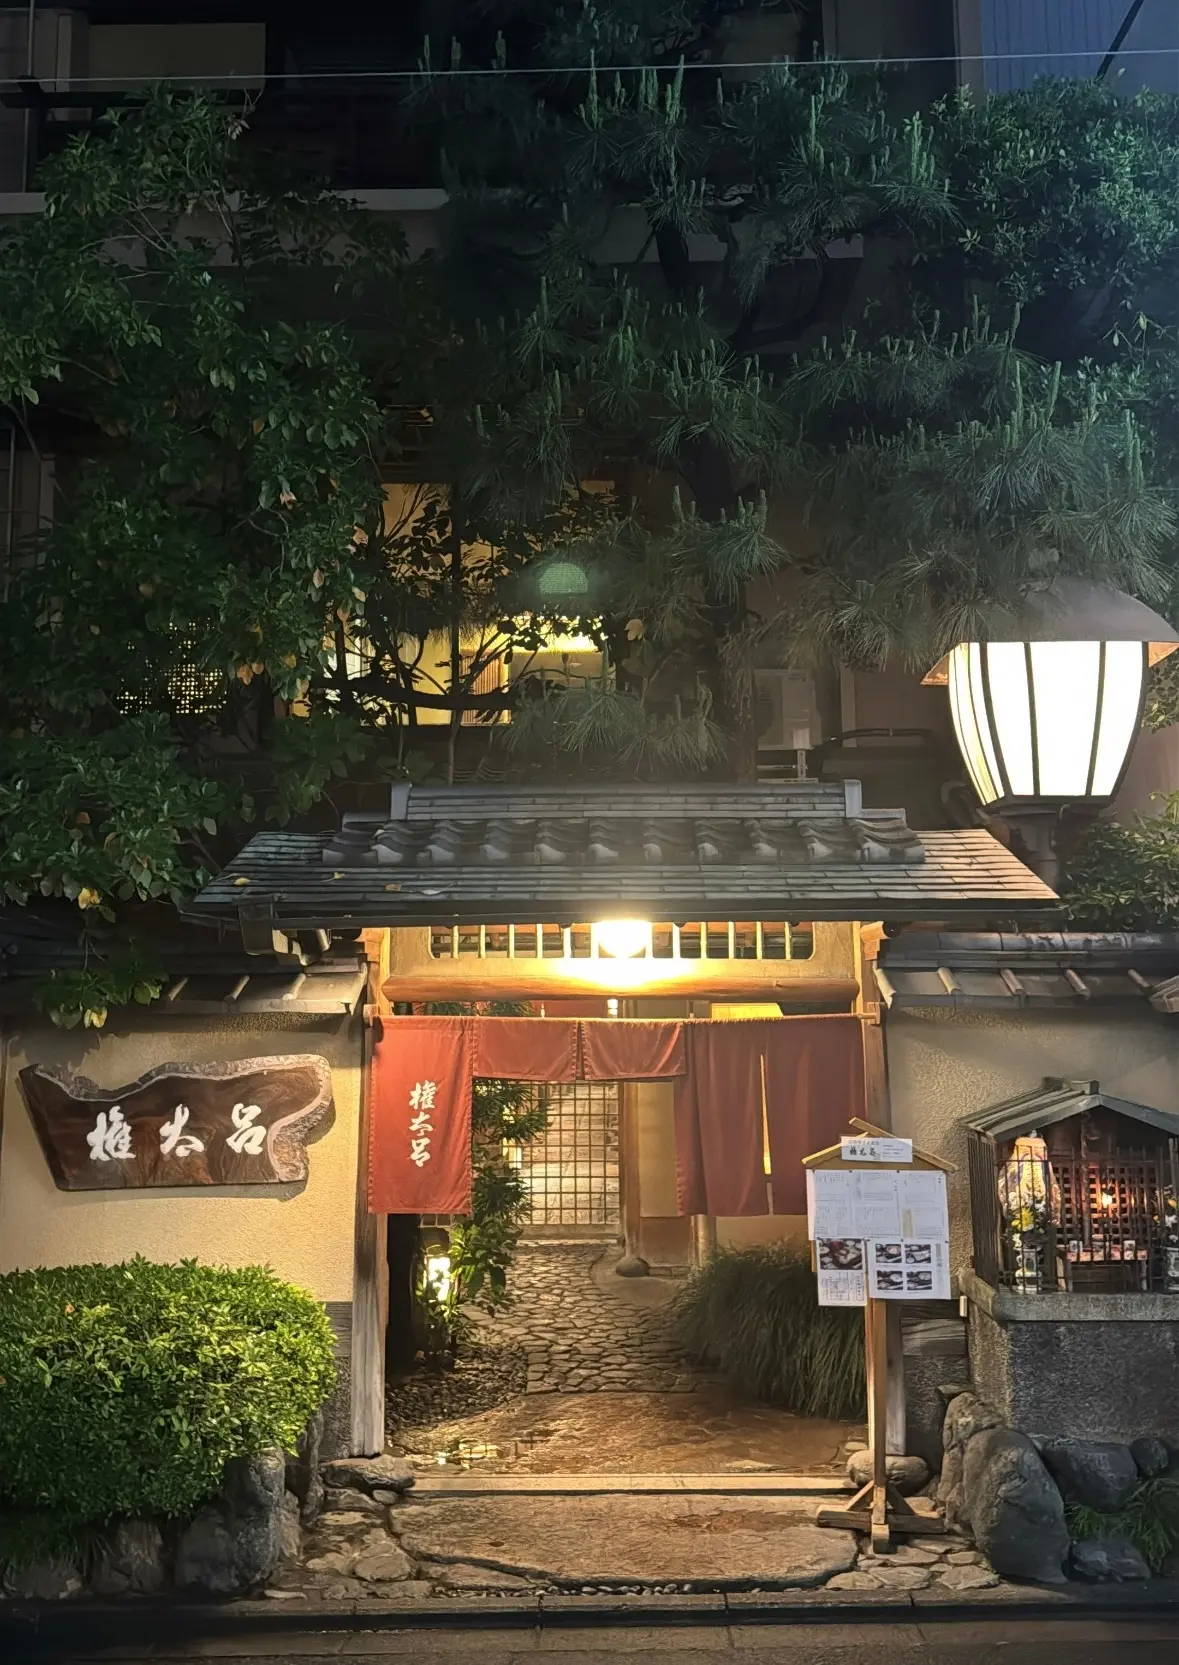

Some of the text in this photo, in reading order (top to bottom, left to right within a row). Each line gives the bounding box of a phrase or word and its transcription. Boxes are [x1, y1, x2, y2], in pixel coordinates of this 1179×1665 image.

[86, 1102, 267, 1162] 権太呂
[408, 1079, 437, 1167] 権太呂
